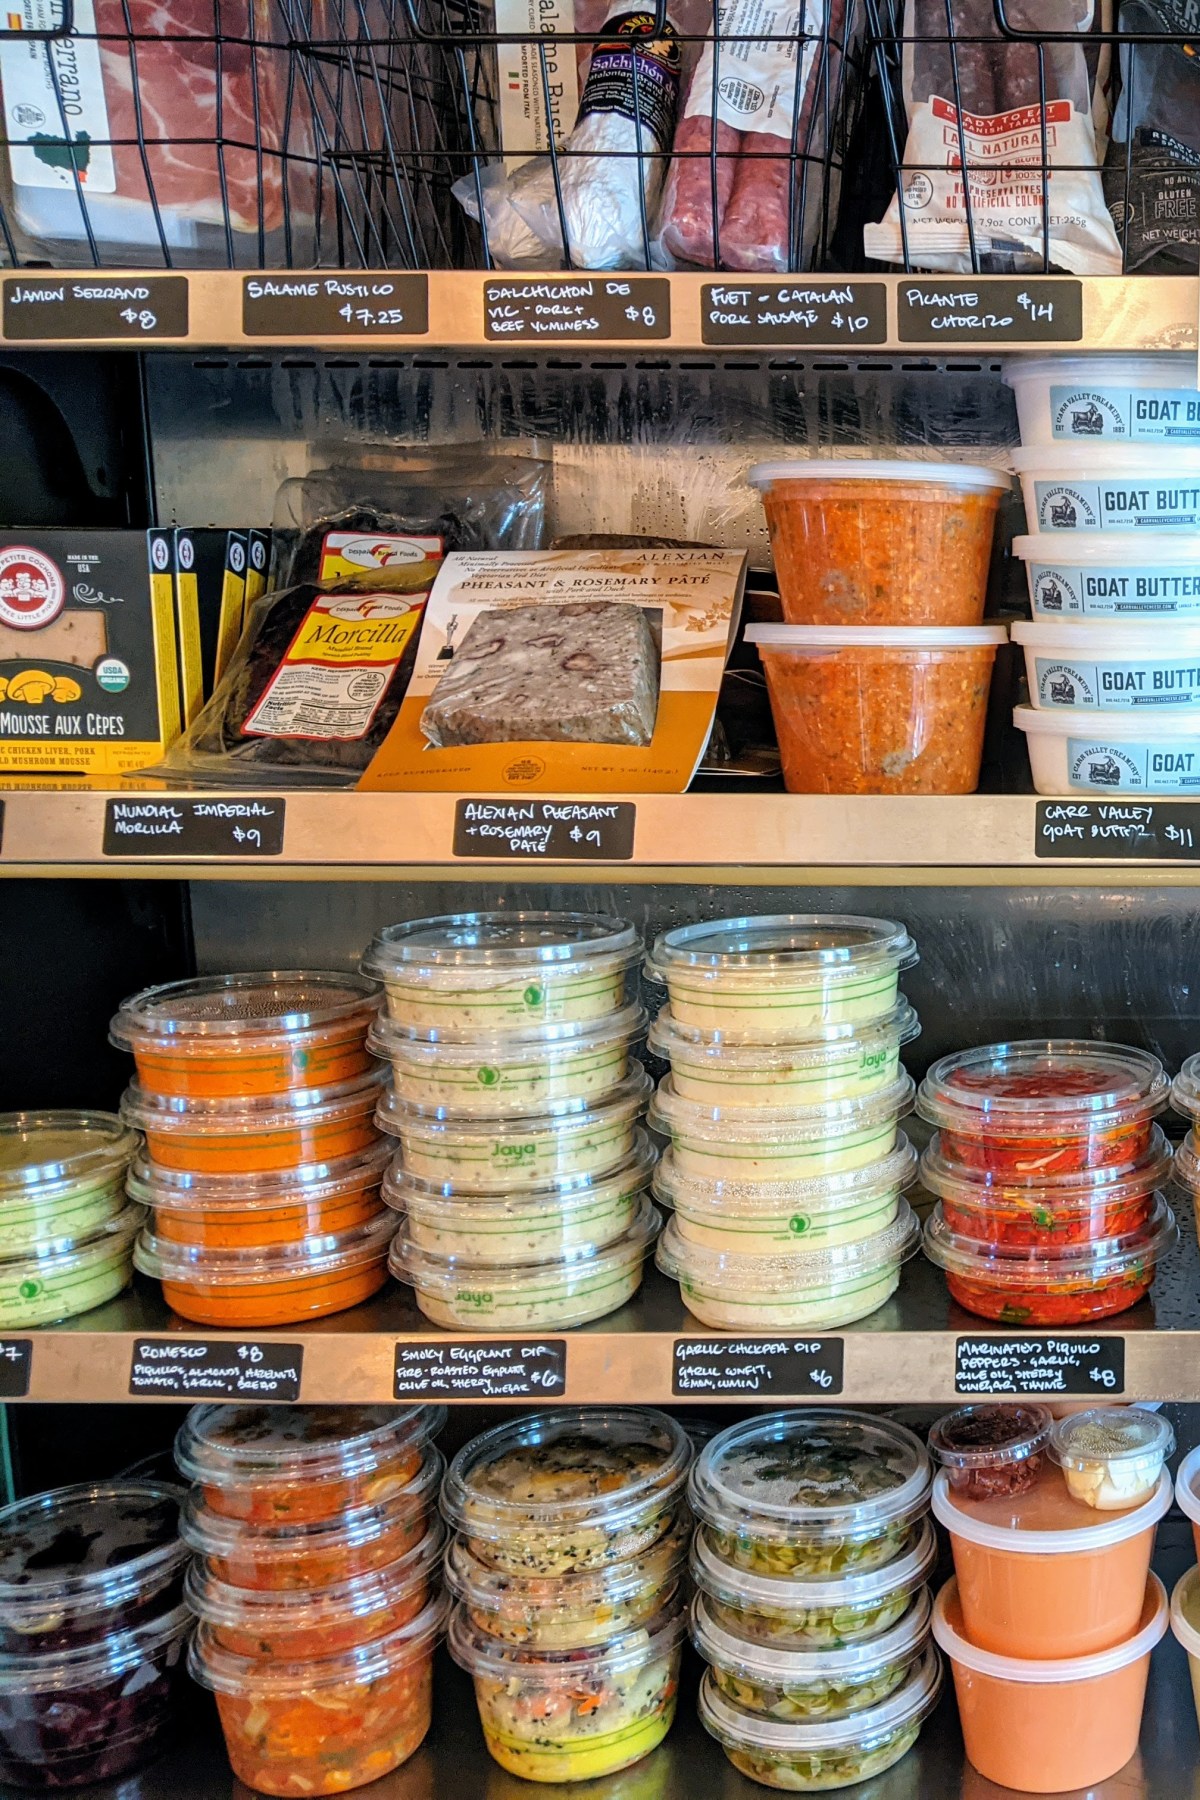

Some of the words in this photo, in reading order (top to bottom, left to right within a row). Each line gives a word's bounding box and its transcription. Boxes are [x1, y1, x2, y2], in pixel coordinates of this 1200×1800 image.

[982, 131, 1050, 155] NATURA
[1155, 198, 1196, 219] FREE
[11, 286, 64, 303] JAMON
[72, 285, 149, 300] SERRANO
[247, 281, 319, 298] SALAME
[487, 281, 593, 301] SALCHICHON
[605, 282, 630, 296] DE
[710, 287, 751, 306] FUET
[778, 286, 853, 305] CATALAN
[339, 303, 403, 326] $7.25
[488, 305, 519, 318] VIC
[906, 289, 979, 307] PICANTE
[1017, 292, 1053, 322] $14
[120, 307, 156, 329] $8
[625, 306, 656, 326] $8
[710, 310, 751, 323] PORK
[757, 310, 818, 328] SAUSAGE
[831, 311, 869, 333] $10
[931, 315, 1014, 329] CHORIZO
[491, 320, 524, 332] BEEF
[1136, 400, 1181, 420] GOAT
[1104, 490, 1150, 511] GOAT
[636, 552, 726, 561] ALEXIAN
[460, 579, 549, 590] PHEASANT
[553, 578, 565, 588] &
[572, 576, 662, 587] ROSEMARY
[667, 573, 711, 585] PÂTÉ
[1086, 577, 1129, 597] GOAT
[304, 623, 408, 644] Morcilla
[103, 667, 122, 675] USDA
[1102, 671, 1147, 690] GOAT
[0, 712, 51, 735] MOUSSE
[55, 714, 82, 735] AUX
[86, 712, 125, 735] CÈPES
[12, 757, 55, 765] MUSHROOM
[1152, 753, 1195, 772] GOAT
[113, 804, 183, 819] MUNDIAL
[193, 803, 275, 818] IMPERIAL
[464, 803, 535, 821] ALEXIAN
[1098, 806, 1153, 824] VALLEY
[115, 821, 184, 834] MORCILLA
[232, 825, 261, 848] $9
[569, 825, 601, 847] $9
[1042, 824, 1085, 843] GOAT
[1164, 824, 1193, 848] $11
[491, 1142, 537, 1160] Jaya
[139, 1346, 208, 1359] ROMESCO
[237, 1345, 264, 1363] $8
[402, 1350, 443, 1364] SMOKY
[450, 1348, 512, 1363] EGGPLANT
[521, 1346, 551, 1359] DIP
[794, 1343, 822, 1354] DIP
[678, 1365, 721, 1378] GARLIC
[960, 1357, 1020, 1370] PEPPERS
[399, 1379, 430, 1391] OLIVE
[451, 1379, 492, 1389] SHERRY
[530, 1370, 559, 1388] $6
[809, 1369, 834, 1388] $6
[1020, 1380, 1067, 1391] THYME
[1089, 1366, 1116, 1387] $8
